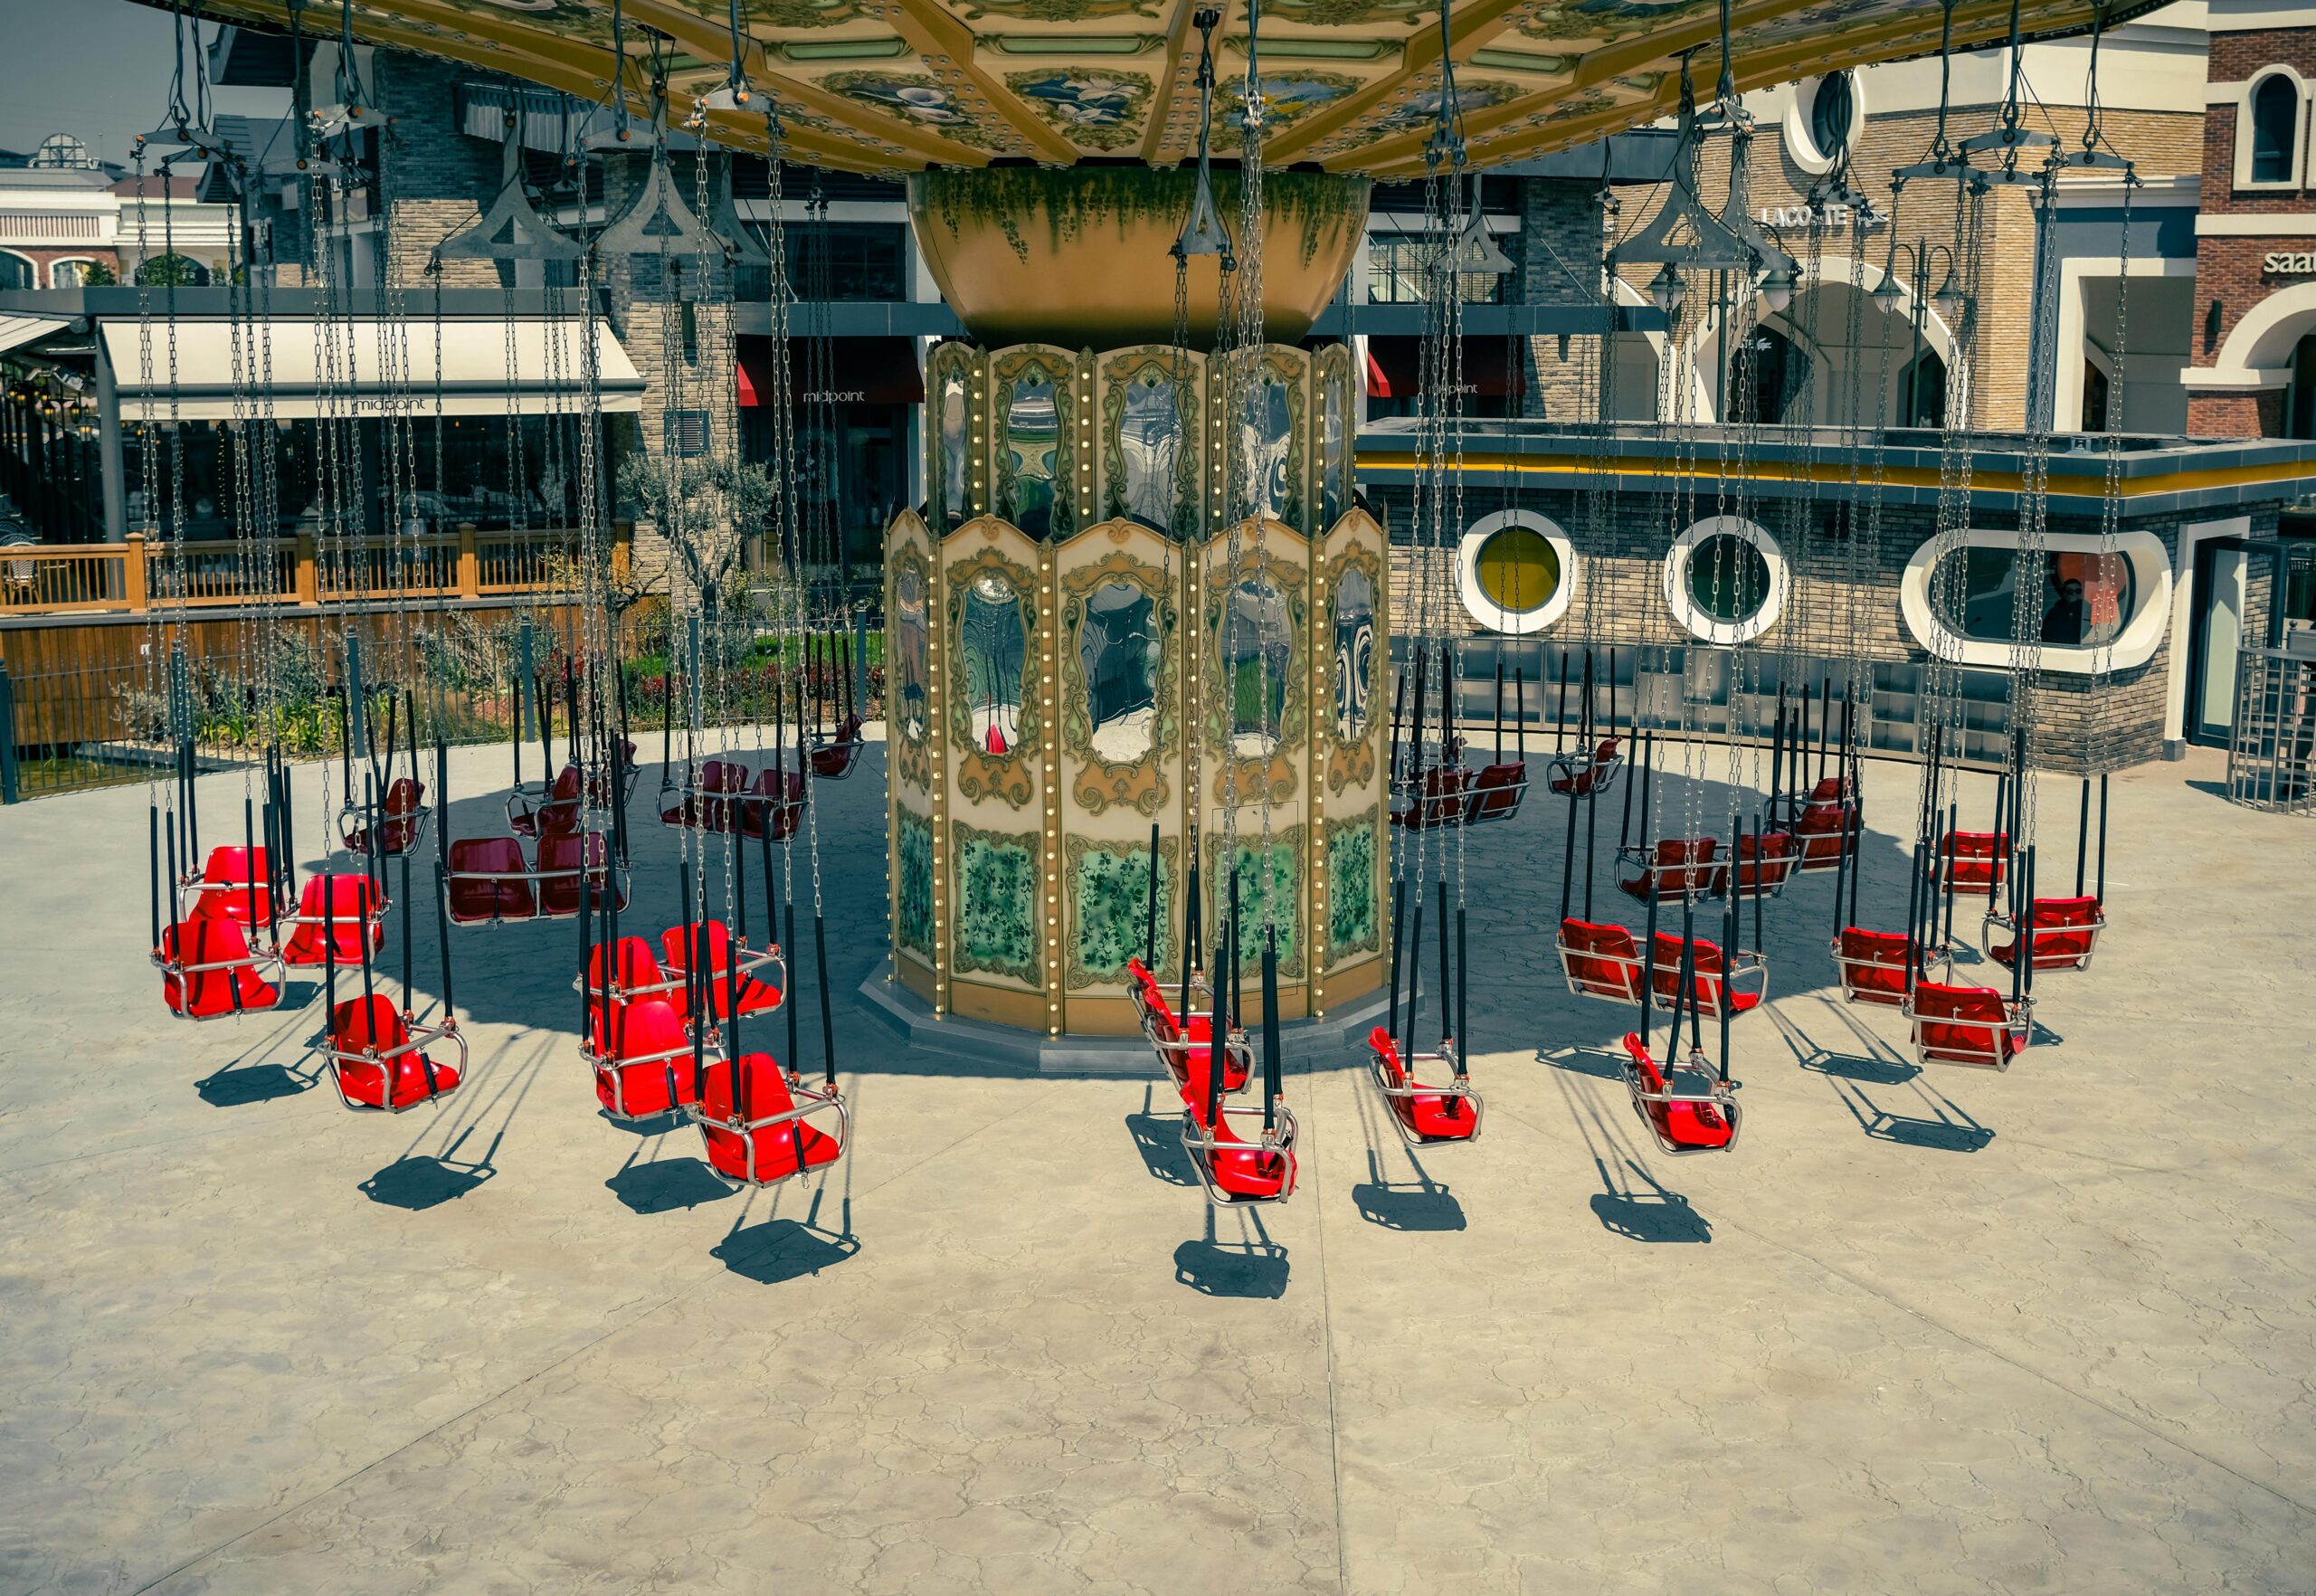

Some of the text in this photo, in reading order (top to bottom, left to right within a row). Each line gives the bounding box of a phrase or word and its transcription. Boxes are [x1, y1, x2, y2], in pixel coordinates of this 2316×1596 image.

[1761, 204, 1848, 227] LACOTE
[2264, 251, 2316, 272] saa
[803, 390, 866, 404] midpoint
[1428, 384, 1478, 396] ipoint
[356, 398, 425, 413] midpont
